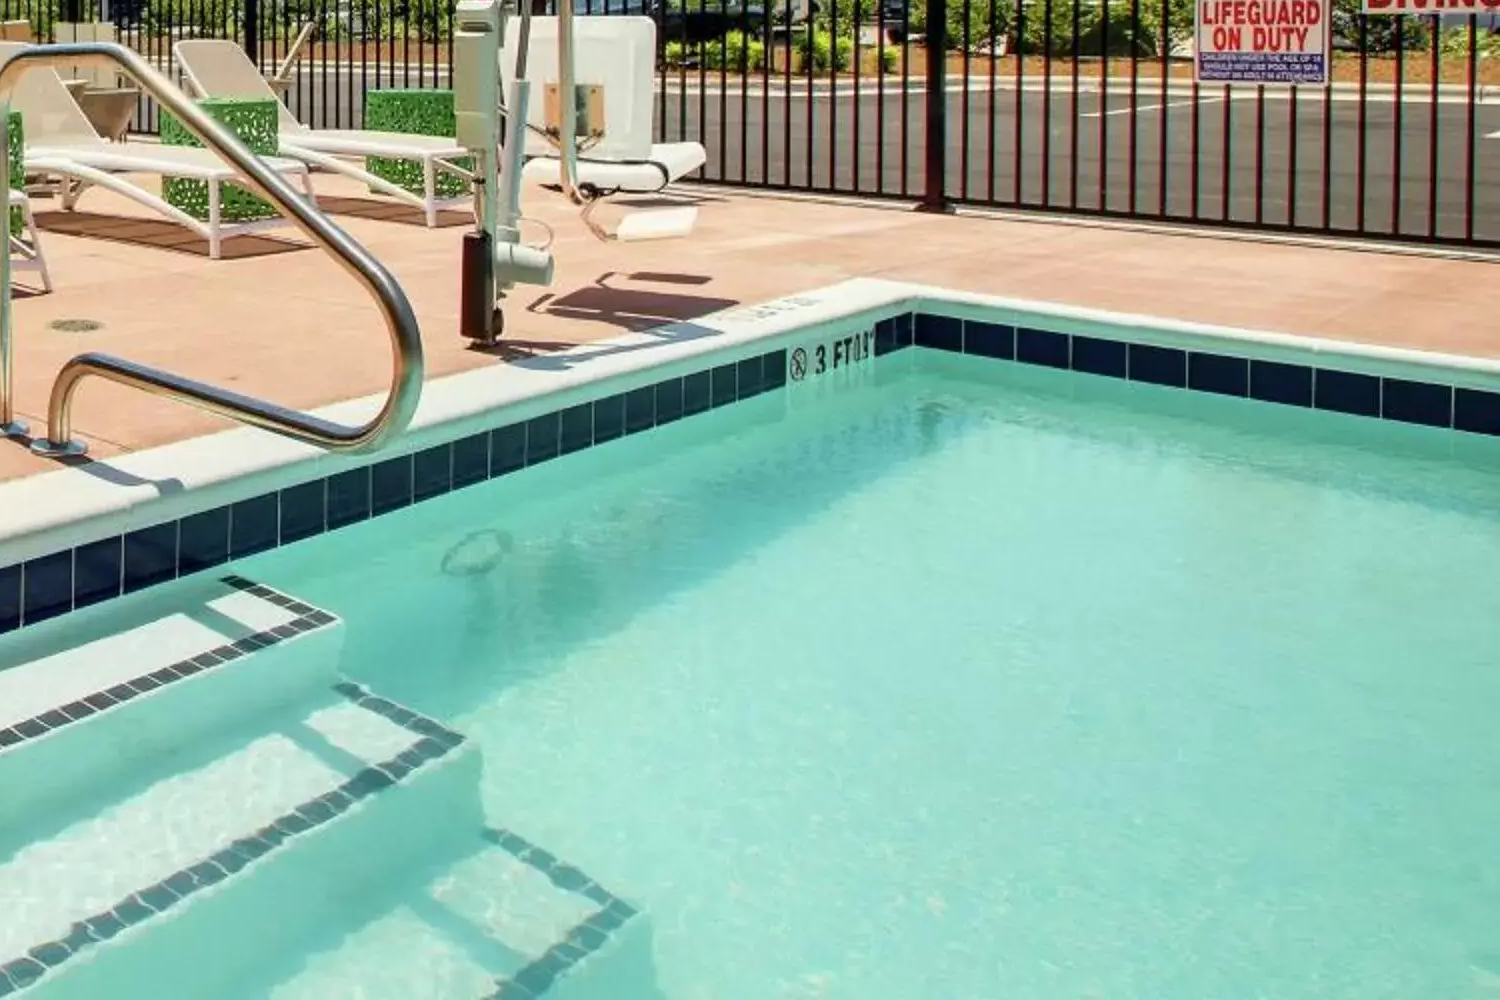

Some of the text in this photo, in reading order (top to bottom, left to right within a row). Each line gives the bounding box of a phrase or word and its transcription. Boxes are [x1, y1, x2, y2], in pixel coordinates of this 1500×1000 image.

[1202, 0, 1321, 25] LIFEGUARD
[1213, 27, 1309, 51] ON DUTY
[815, 345, 827, 375] 3
[833, 337, 853, 369] FT
